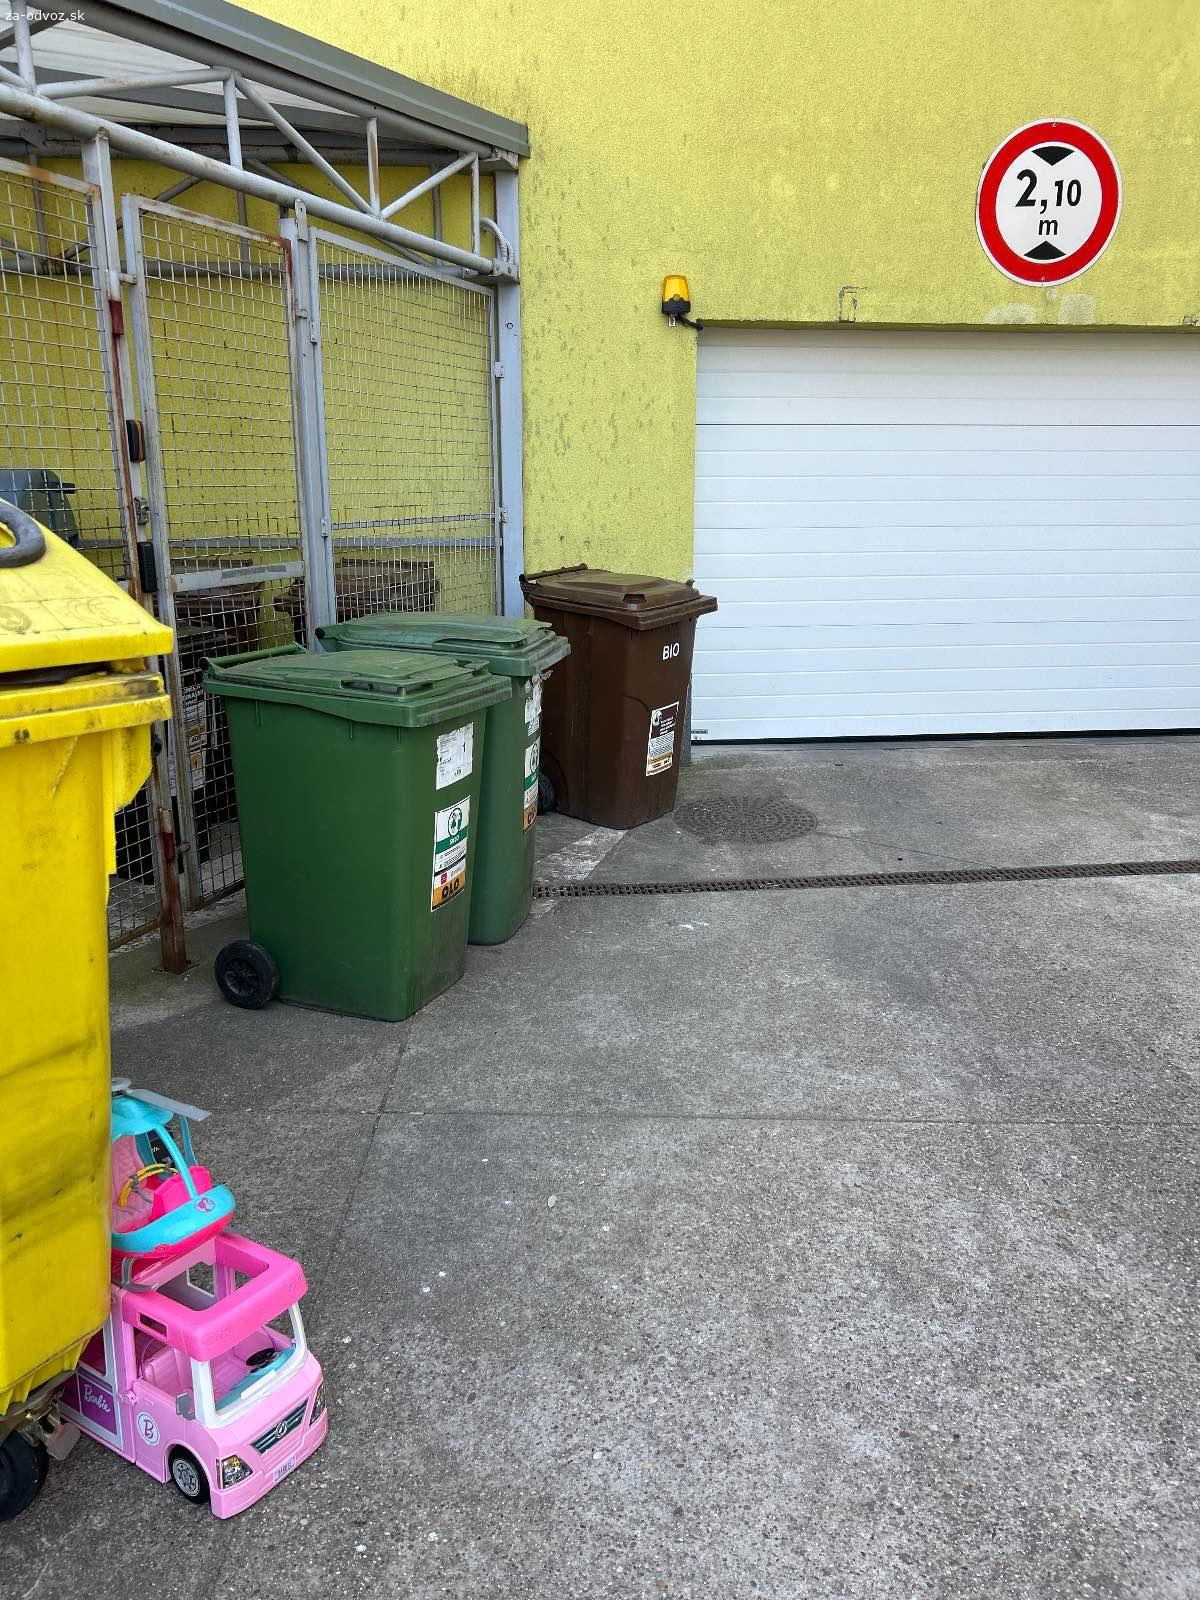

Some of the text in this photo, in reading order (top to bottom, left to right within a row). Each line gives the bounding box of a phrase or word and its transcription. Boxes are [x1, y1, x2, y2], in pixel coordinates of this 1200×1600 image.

[1015, 169, 1082, 214] 2,10
[1038, 219, 1059, 236] m
[662, 642, 680, 660] BIO
[84, 1383, 111, 1413] Barbie
